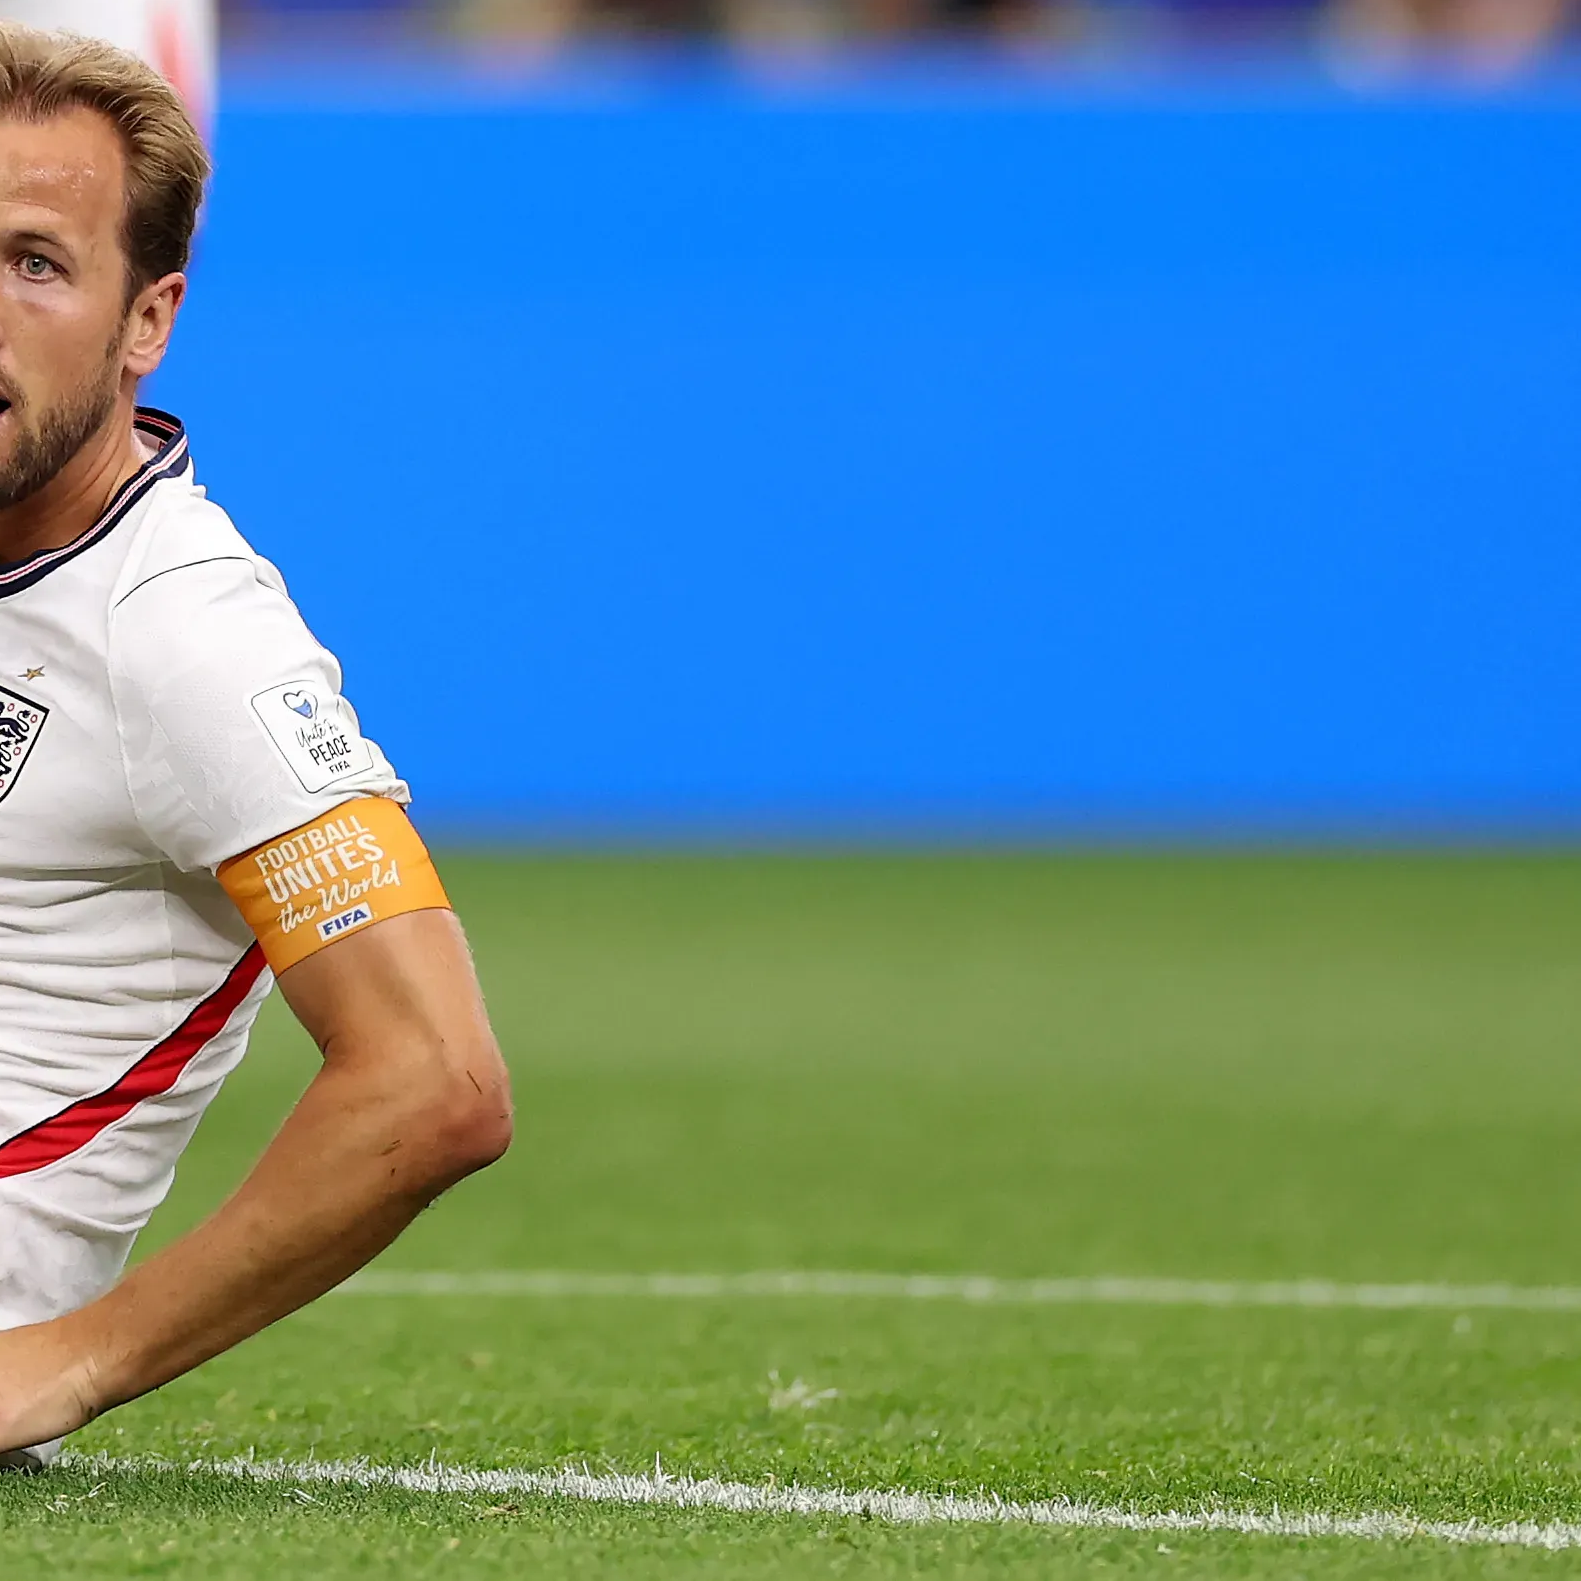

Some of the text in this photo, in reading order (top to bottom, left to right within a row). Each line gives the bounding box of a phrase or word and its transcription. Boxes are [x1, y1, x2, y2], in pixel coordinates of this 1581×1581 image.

[309, 734, 351, 766] PEACE
[329, 760, 351, 774] FIFA
[254, 815, 371, 876] FOOTBALL
[264, 833, 385, 904] UNITES
[276, 860, 401, 934] the World
[322, 908, 368, 936] FIFA
